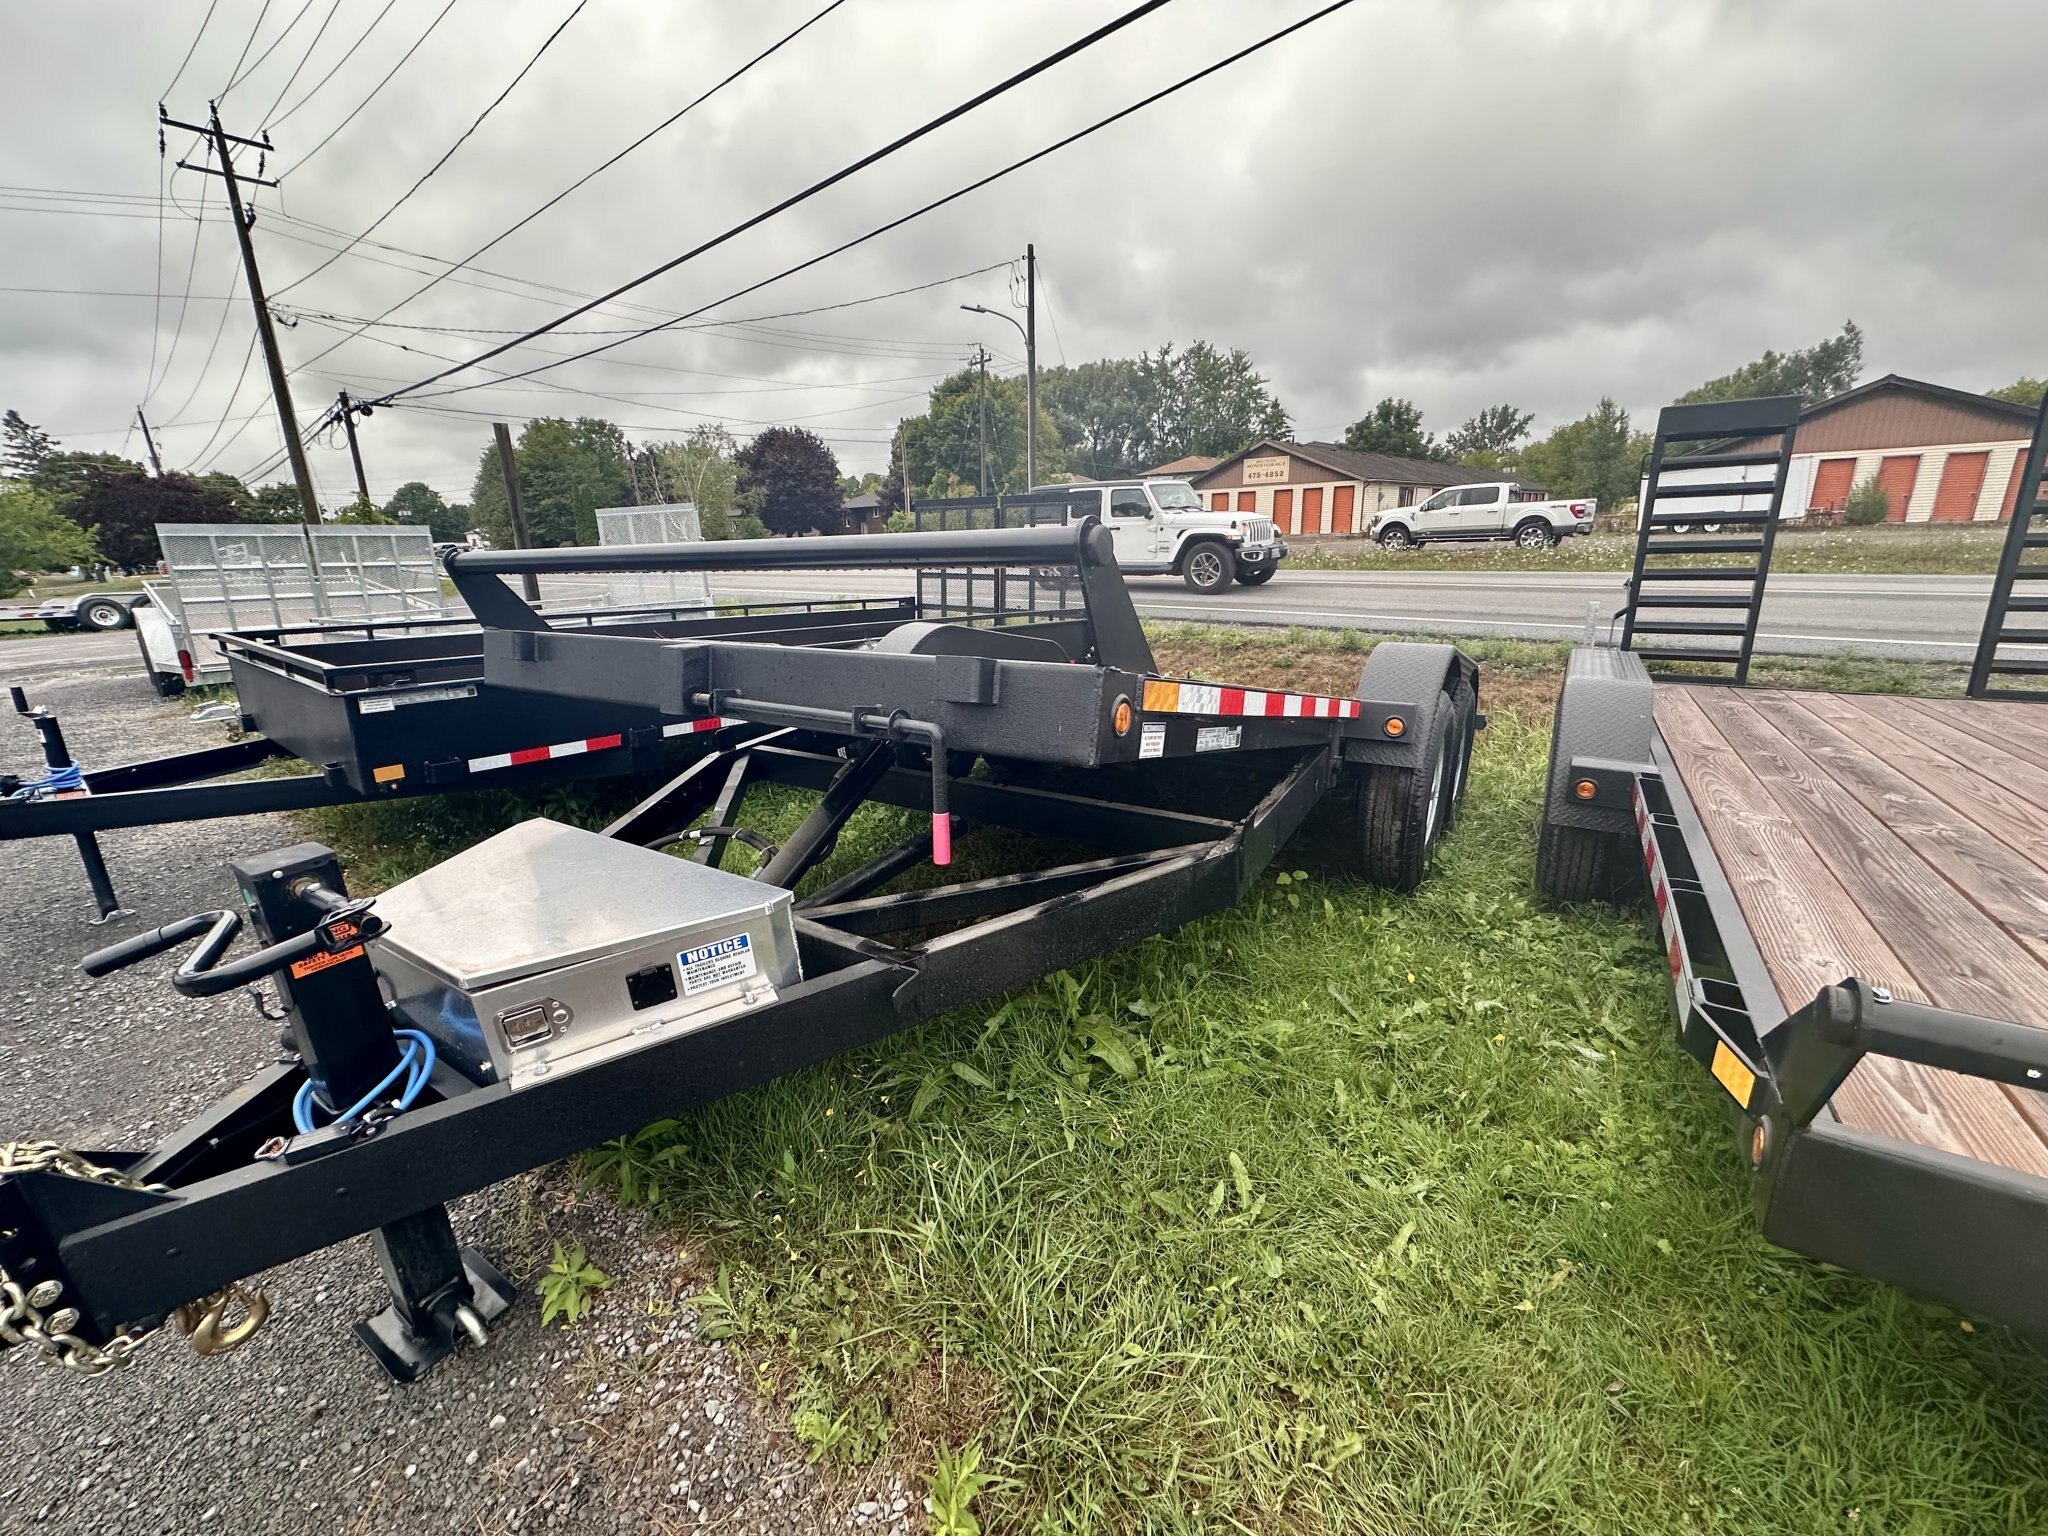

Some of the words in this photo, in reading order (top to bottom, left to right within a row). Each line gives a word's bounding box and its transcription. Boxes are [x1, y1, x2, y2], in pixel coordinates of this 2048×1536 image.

[686, 937, 743, 964] NOTICE
[687, 964, 715, 975] MAINTENANCE
[688, 969, 716, 980] MAINTENANCE
